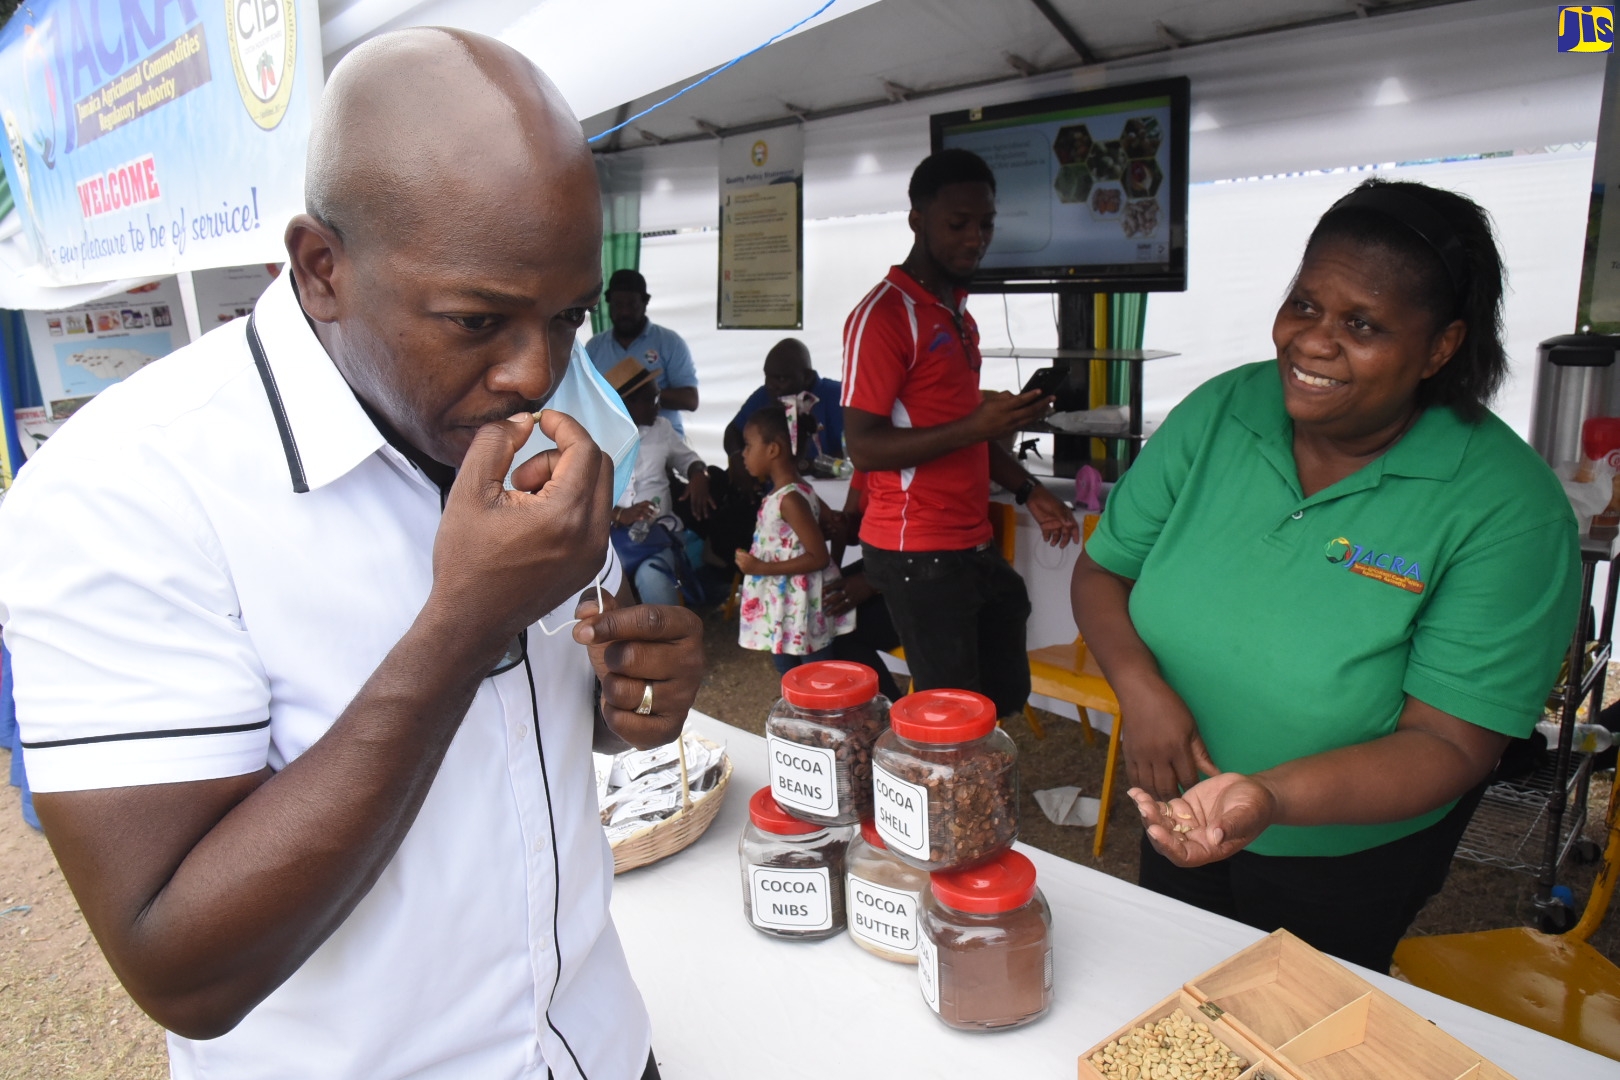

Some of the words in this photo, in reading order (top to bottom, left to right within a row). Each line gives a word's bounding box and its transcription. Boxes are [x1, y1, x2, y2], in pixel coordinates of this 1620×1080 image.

[237, 0, 279, 39] CIB
[77, 97, 100, 124] Jamaica
[102, 68, 143, 107] Agricultural
[143, 34, 200, 81] Commodities
[99, 101, 135, 131] Regulatory
[137, 77, 175, 112] Authority
[78, 158, 160, 218] WELCOME
[60, 244, 78, 264] our
[80, 231, 127, 268] pleasure
[129, 221, 144, 252] to
[147, 214, 165, 248] be
[172, 208, 186, 255] of
[193, 187, 260, 240] service!
[1343, 544, 1421, 581] JACRA
[775, 750, 823, 776] COCOA
[779, 776, 822, 800] BEANS
[876, 778, 914, 812] COCOA
[880, 814, 911, 838] SHELL
[761, 879, 817, 894] COCOA
[772, 903, 808, 917] NIBS
[856, 890, 907, 917] COCOA
[856, 913, 910, 941] BUTTER
